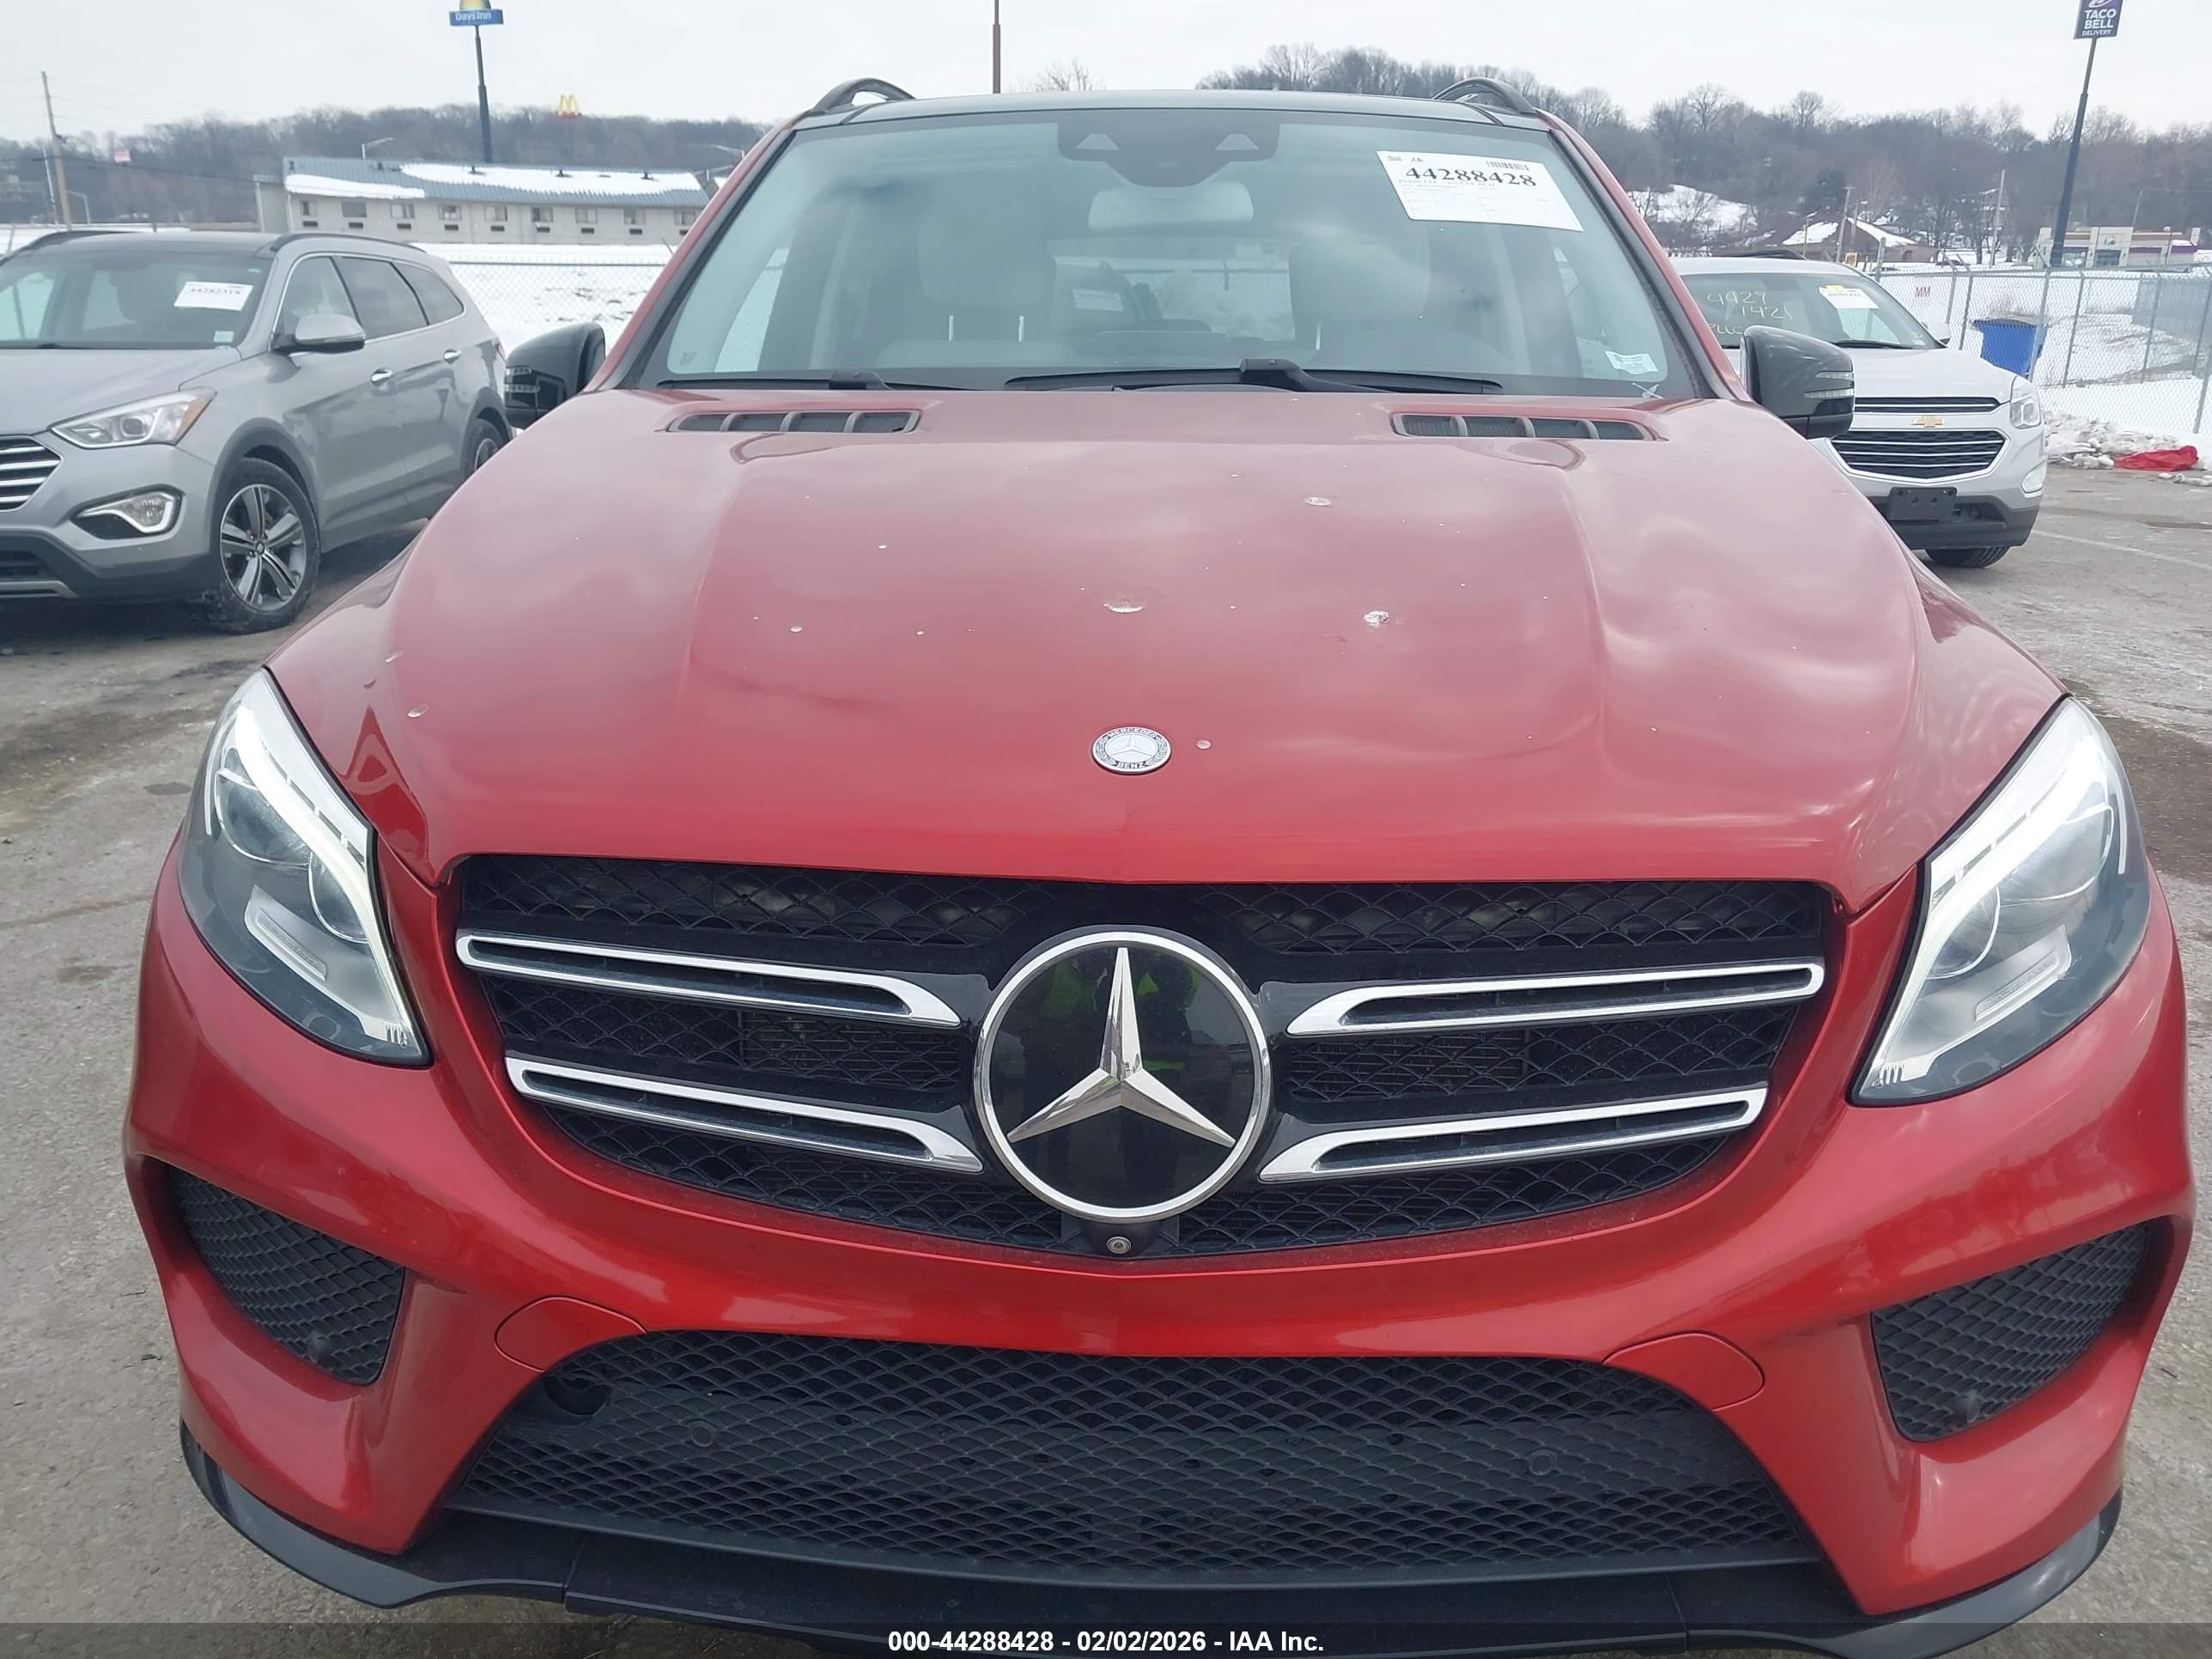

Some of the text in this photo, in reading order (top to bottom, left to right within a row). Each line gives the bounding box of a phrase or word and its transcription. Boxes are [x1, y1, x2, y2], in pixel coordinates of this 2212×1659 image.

[477, 11, 492, 21] Inn
[2084, 8, 2117, 20] TACO
[2083, 18, 2114, 30] BELL
[1405, 167, 1537, 187] 44288428
[1741, 304, 1794, 320] 1421
[1116, 762, 1147, 770] BENZ
